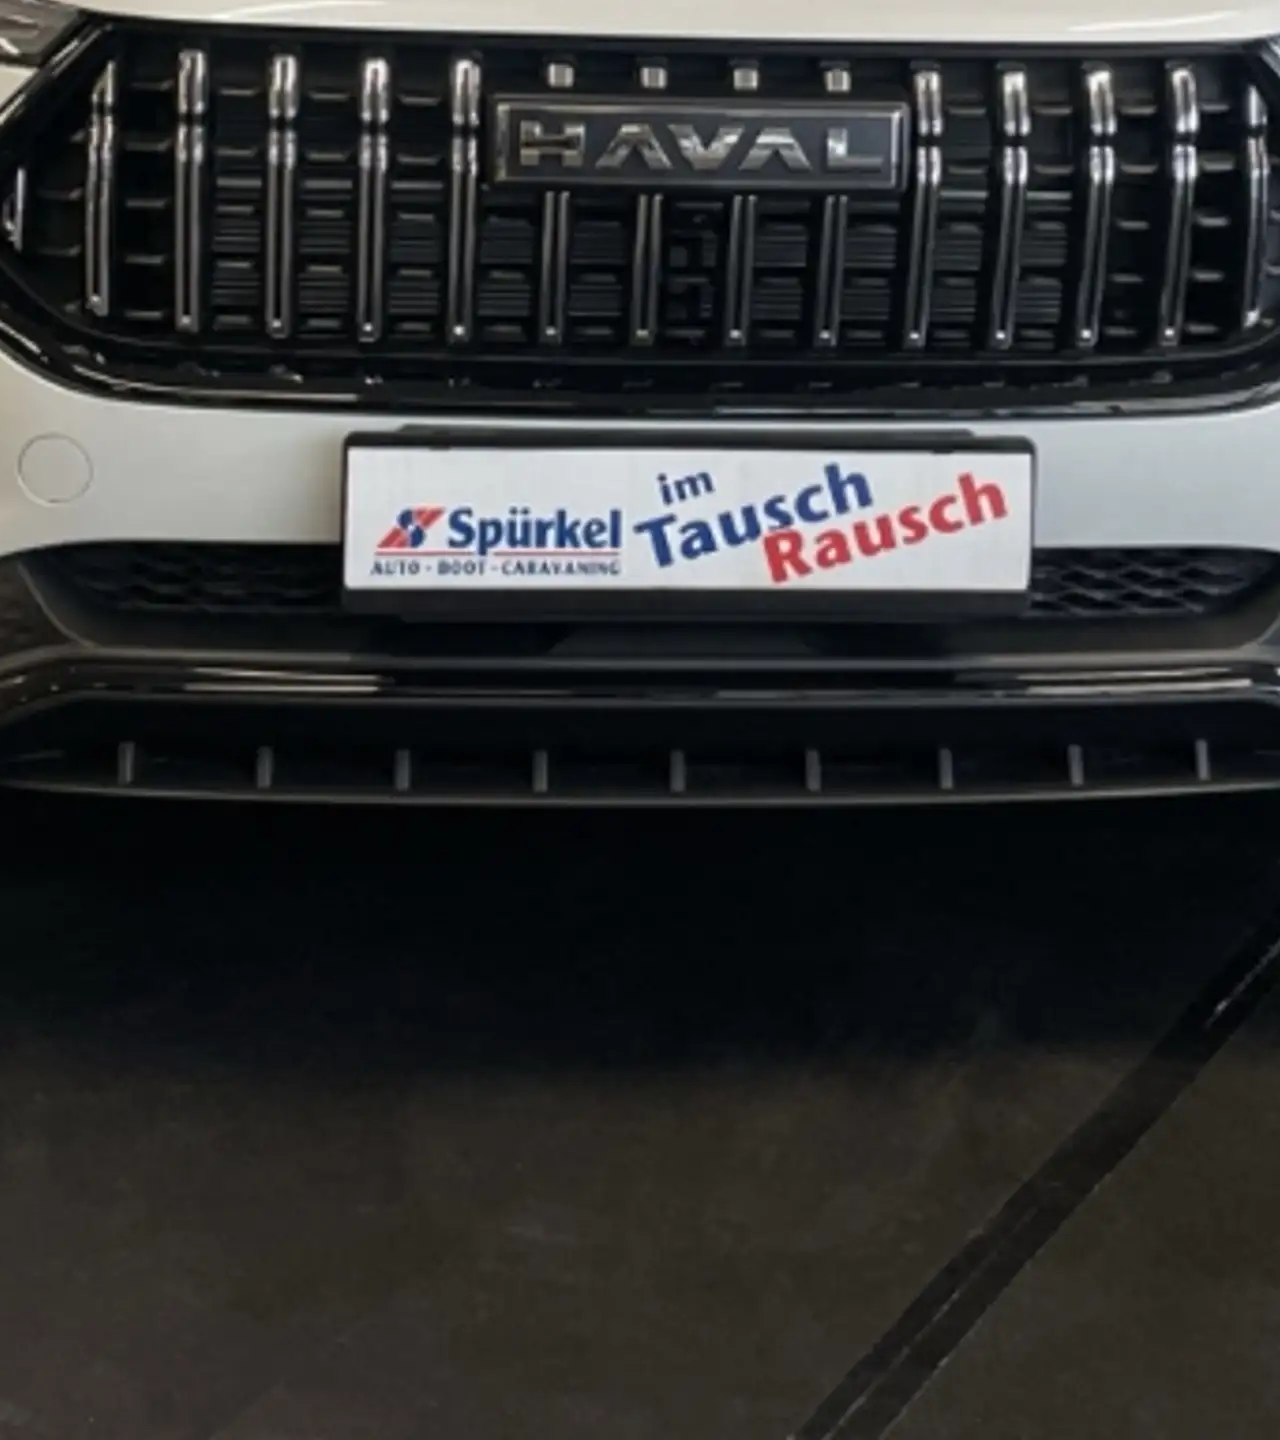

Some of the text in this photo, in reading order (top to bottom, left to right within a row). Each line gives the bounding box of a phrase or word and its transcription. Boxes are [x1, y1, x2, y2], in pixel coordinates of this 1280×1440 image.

[519, 119, 886, 174] HAVAL
[657, 470, 716, 506] im
[447, 506, 622, 557] Spürkel
[633, 462, 874, 569] Tausch
[762, 471, 1009, 584] Rausch
[370, 561, 621, 576] AUTO BOOT CARAVANING
